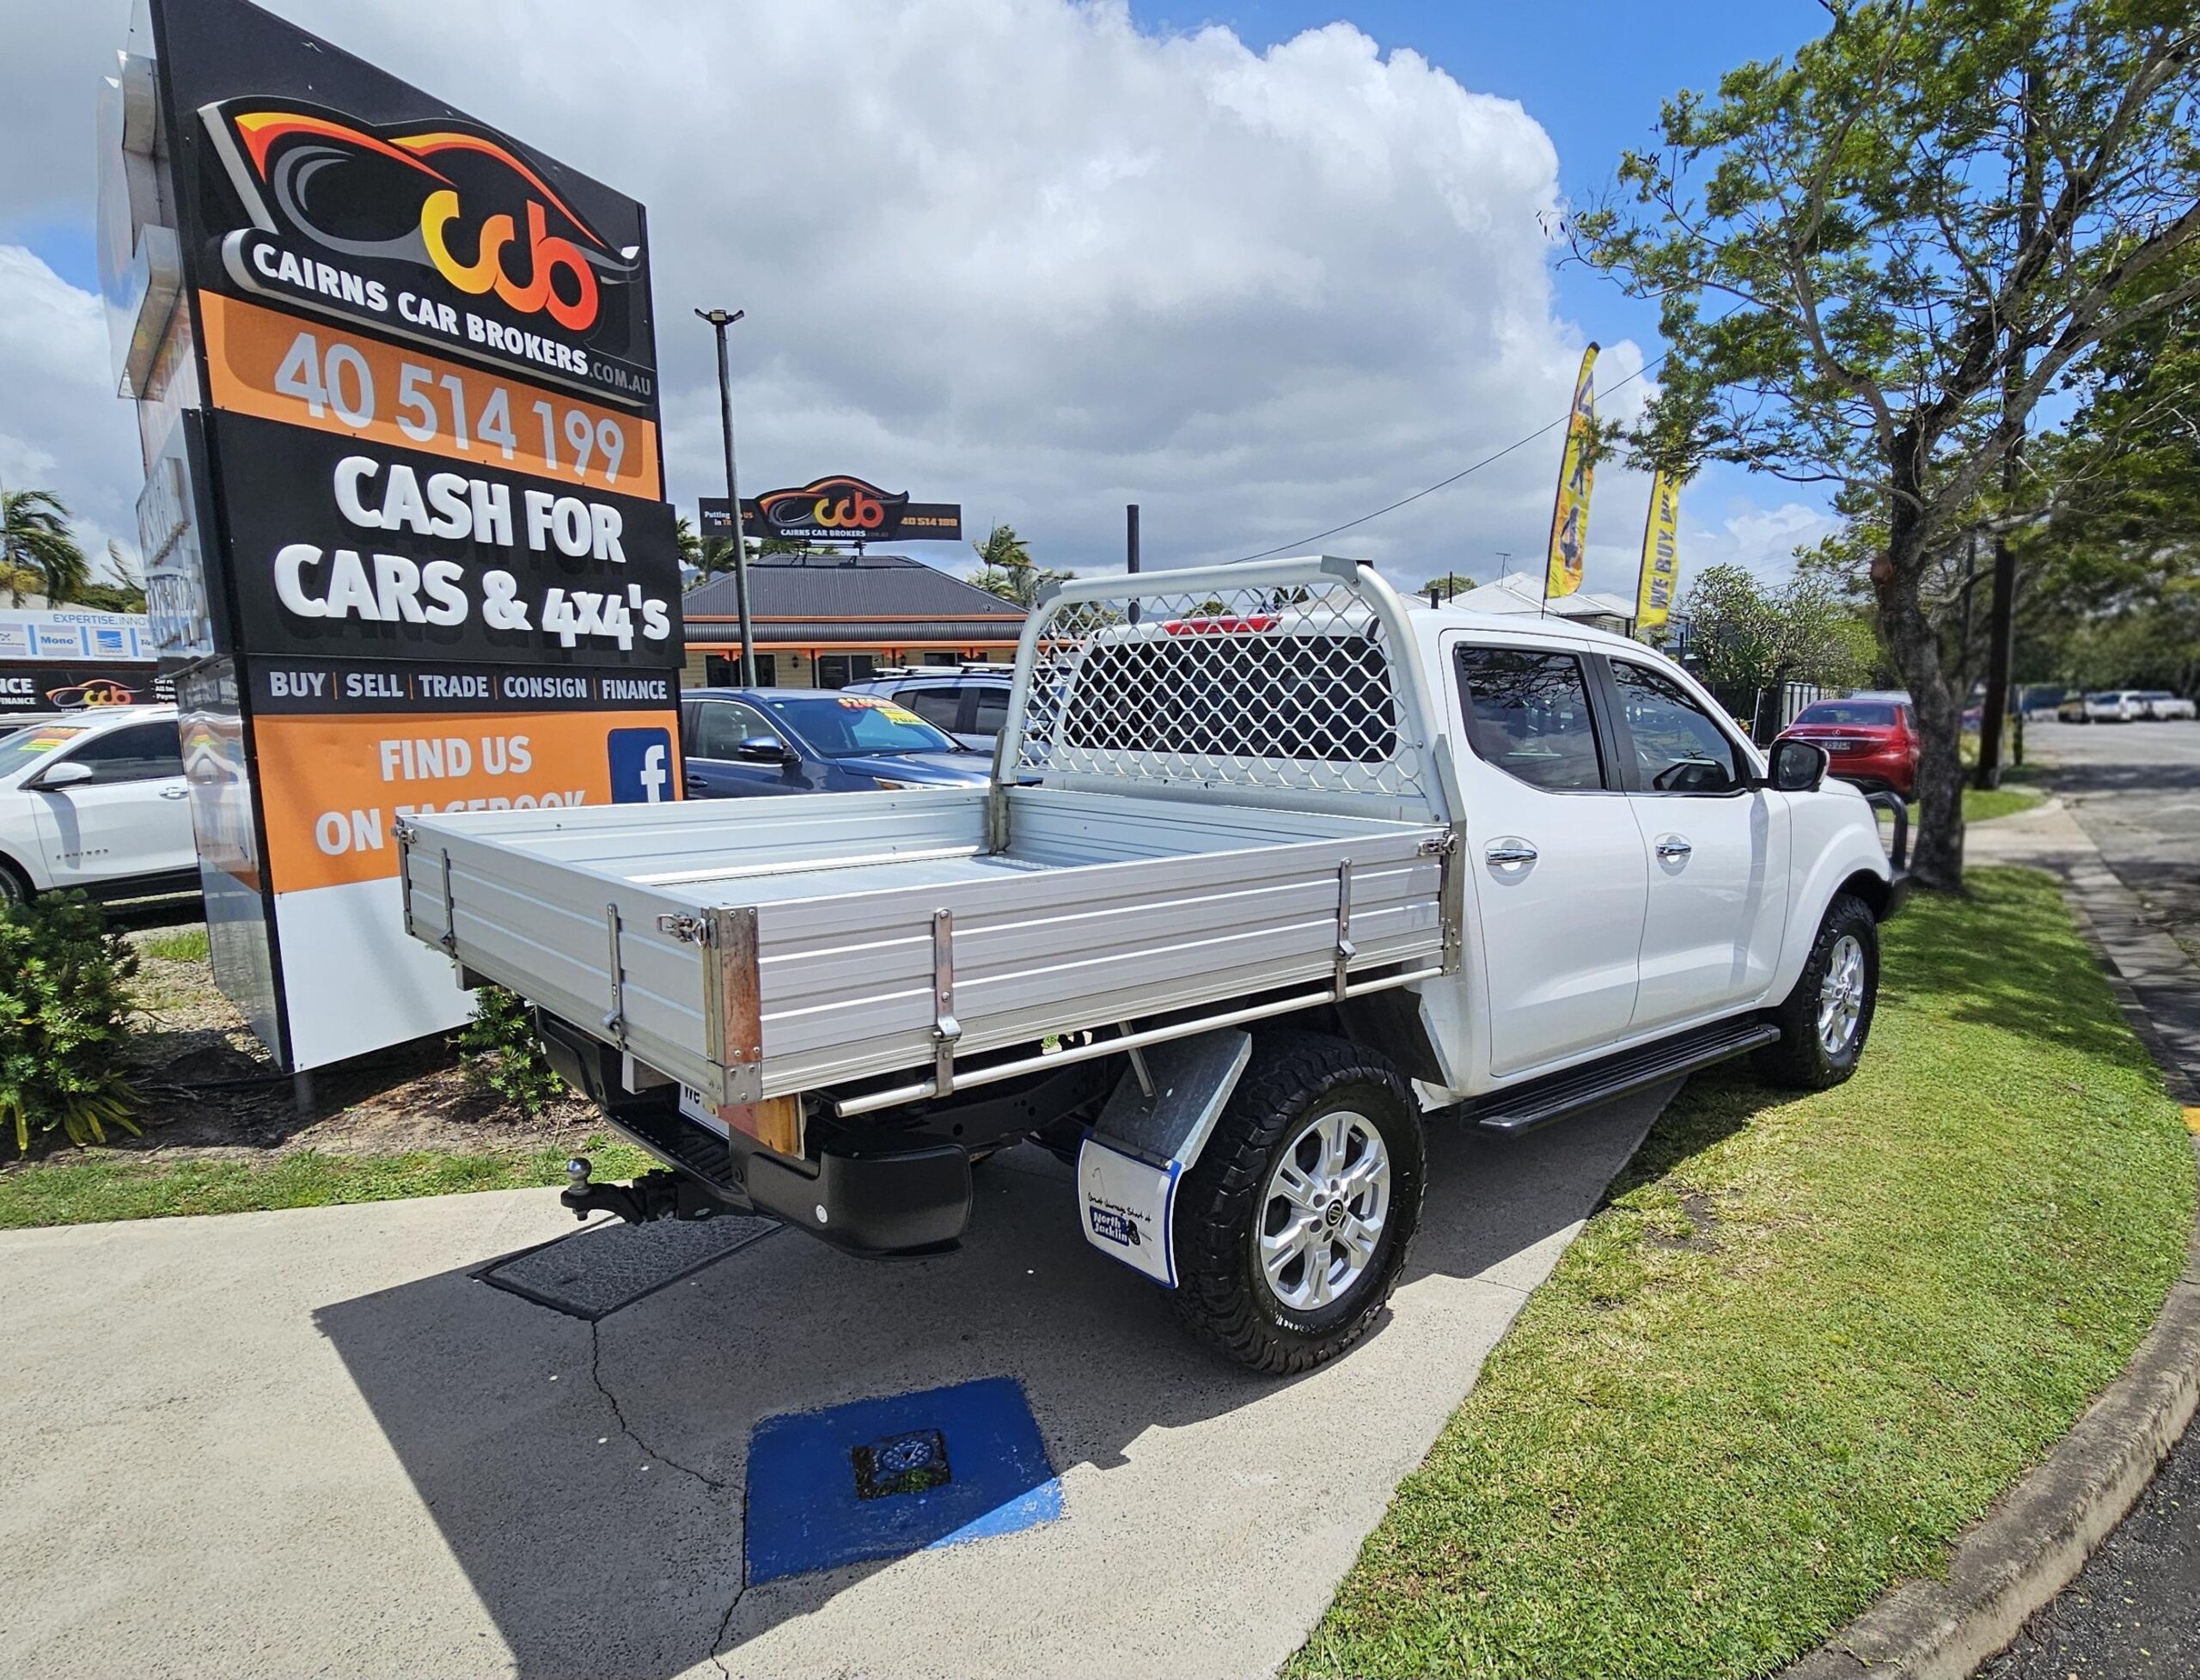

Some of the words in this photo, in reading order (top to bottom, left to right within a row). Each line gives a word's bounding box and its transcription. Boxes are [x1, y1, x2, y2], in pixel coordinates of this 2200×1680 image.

[252, 242, 389, 313] CAIRNS
[397, 291, 461, 337] CAR
[273, 331, 376, 429] 40
[394, 362, 517, 461] 514
[531, 400, 626, 485] 199
[333, 455, 515, 547] CASH
[524, 489, 627, 564] FOR
[901, 516, 914, 526] 40
[917, 517, 937, 527] 514
[938, 517, 958, 527] 199
[780, 528, 810, 537] CAIRNS
[811, 528, 828, 537] CAR
[273, 543, 469, 626] CARS
[481, 569, 534, 631] &
[1650, 577, 1670, 609] WE
[40, 636, 75, 645] Mono
[268, 670, 327, 698] BUY
[345, 672, 405, 699] SELL
[418, 674, 490, 699] TRADE
[503, 675, 589, 699] CONSIGN
[602, 678, 669, 701] FINANCE
[377, 736, 474, 782] FIND
[480, 735, 534, 775] US
[315, 808, 385, 856] ON
[1093, 1212, 1121, 1229] North
[1094, 1222, 1128, 1243] Jacklin
